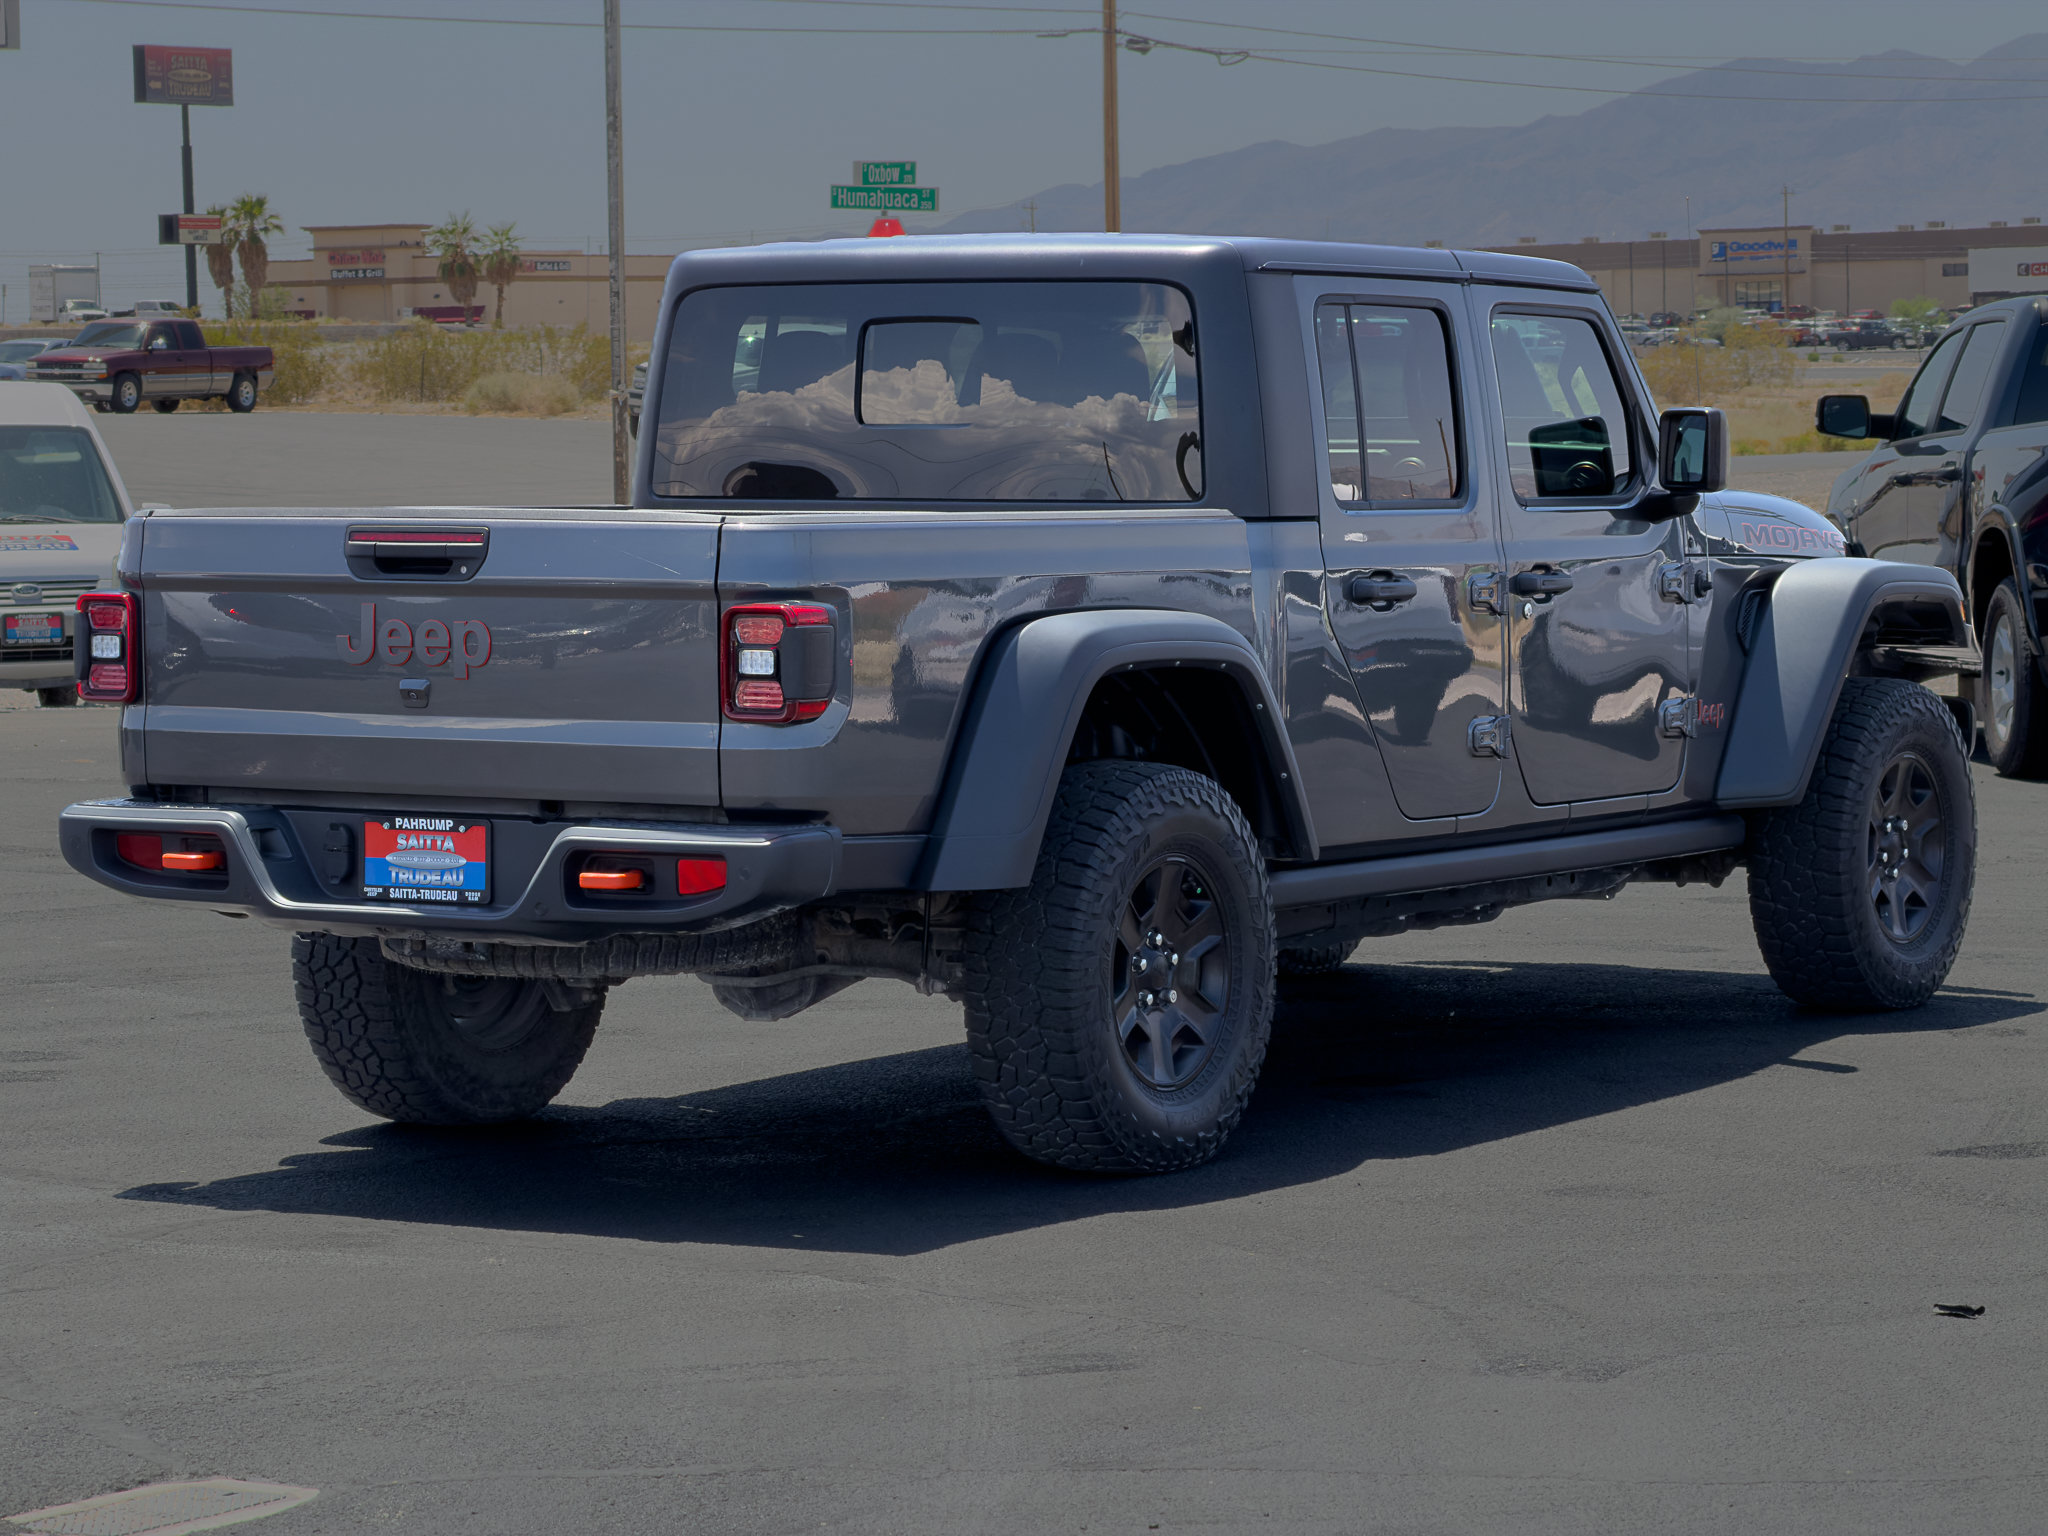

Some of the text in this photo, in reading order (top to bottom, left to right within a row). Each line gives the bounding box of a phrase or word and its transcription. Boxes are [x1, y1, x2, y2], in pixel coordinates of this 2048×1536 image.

[868, 165, 900, 183] Oxbow
[837, 187, 919, 209] Humahuaca
[1729, 239, 1798, 252] Goodwll
[332, 270, 356, 279] Buffet
[366, 269, 383, 278] Grill
[1741, 522, 1846, 553] MOJAVE
[336, 603, 492, 681] Jeep
[1697, 699, 1724, 729] Jeep
[395, 818, 454, 831] PAHRUMP
[396, 833, 456, 853] SAITTA
[388, 866, 464, 887] TRUDEAU
[389, 888, 458, 901] SAITTA-TRUDEAU
